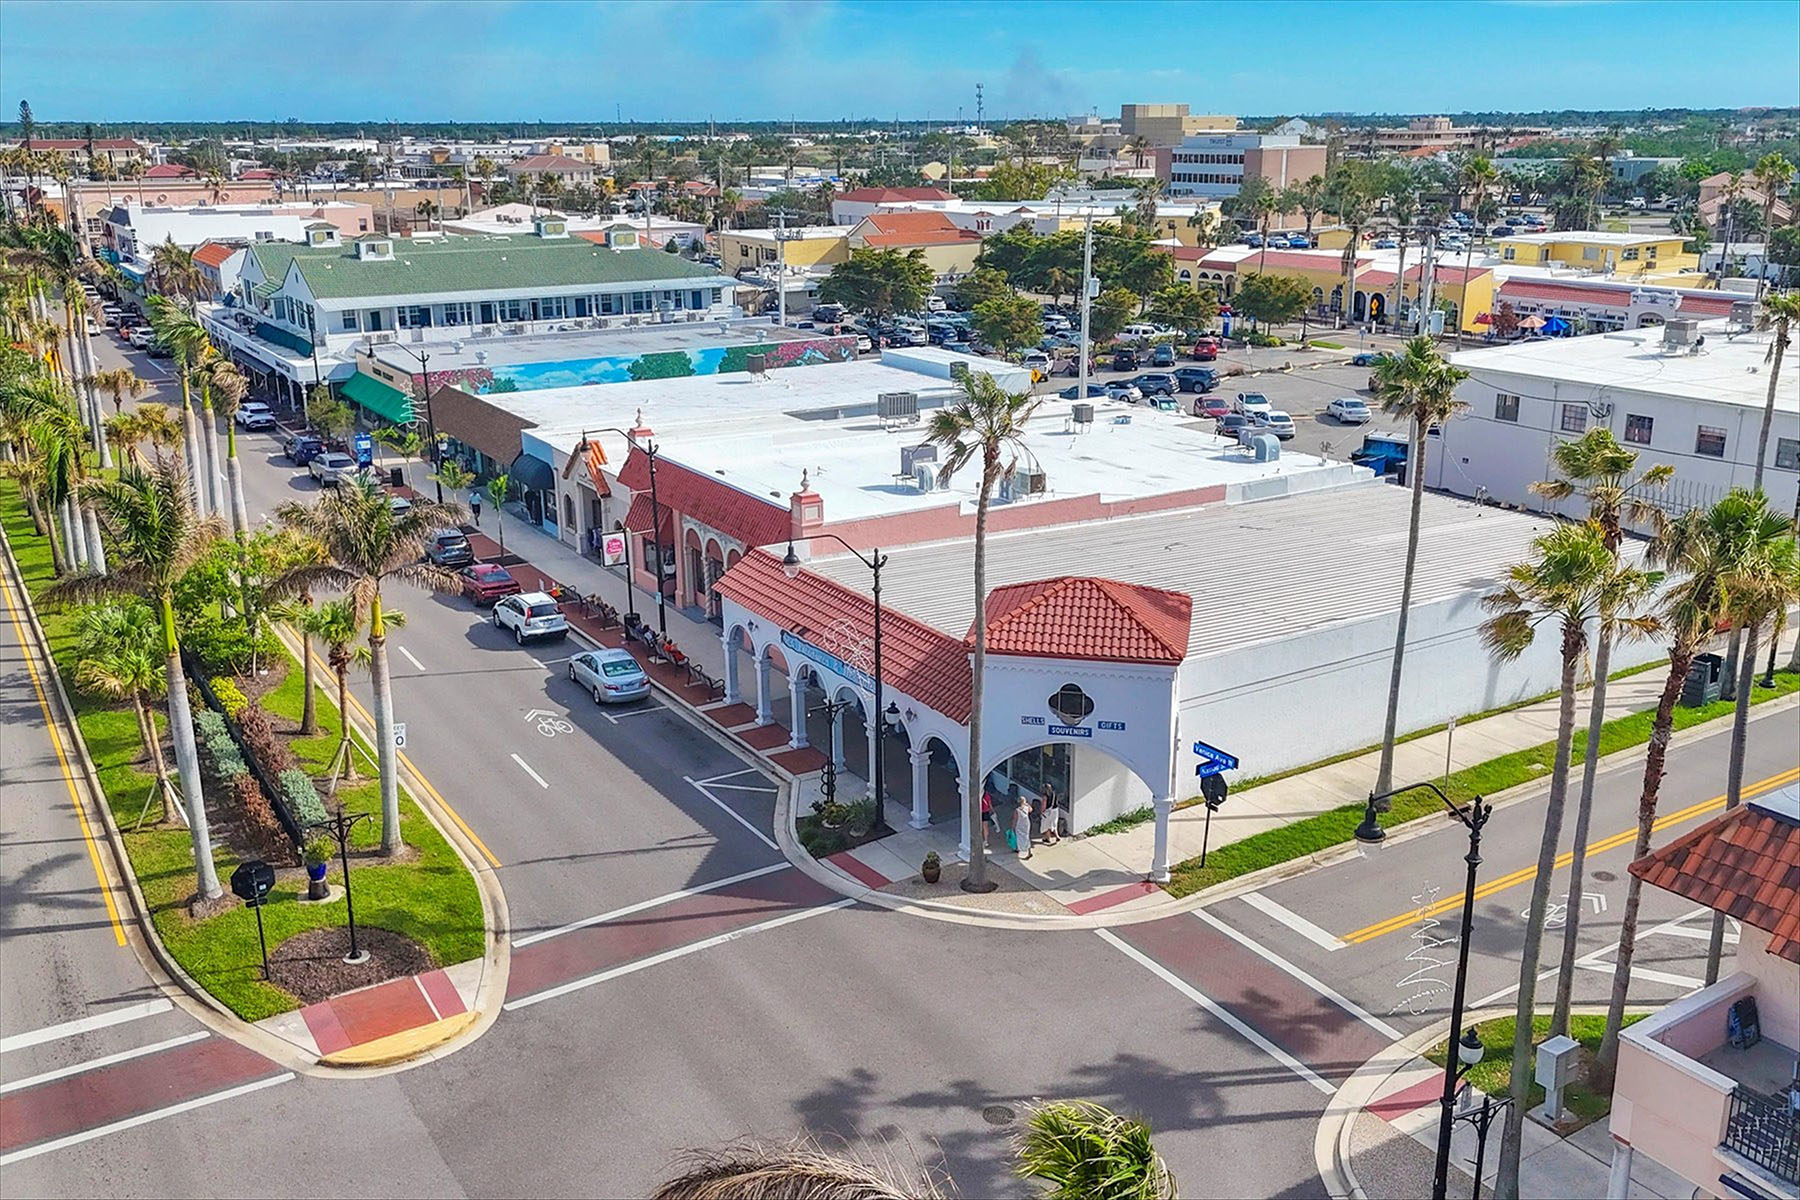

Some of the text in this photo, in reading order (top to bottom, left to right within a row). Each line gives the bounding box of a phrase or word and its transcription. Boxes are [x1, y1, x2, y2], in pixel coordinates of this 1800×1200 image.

[1022, 716, 1045, 725] SHELLS
[1101, 721, 1122, 730] GIFTS
[1052, 726, 1089, 736] SOUVENIRS
[395, 735, 404, 746] 0
[1194, 744, 1214, 759] Venice
